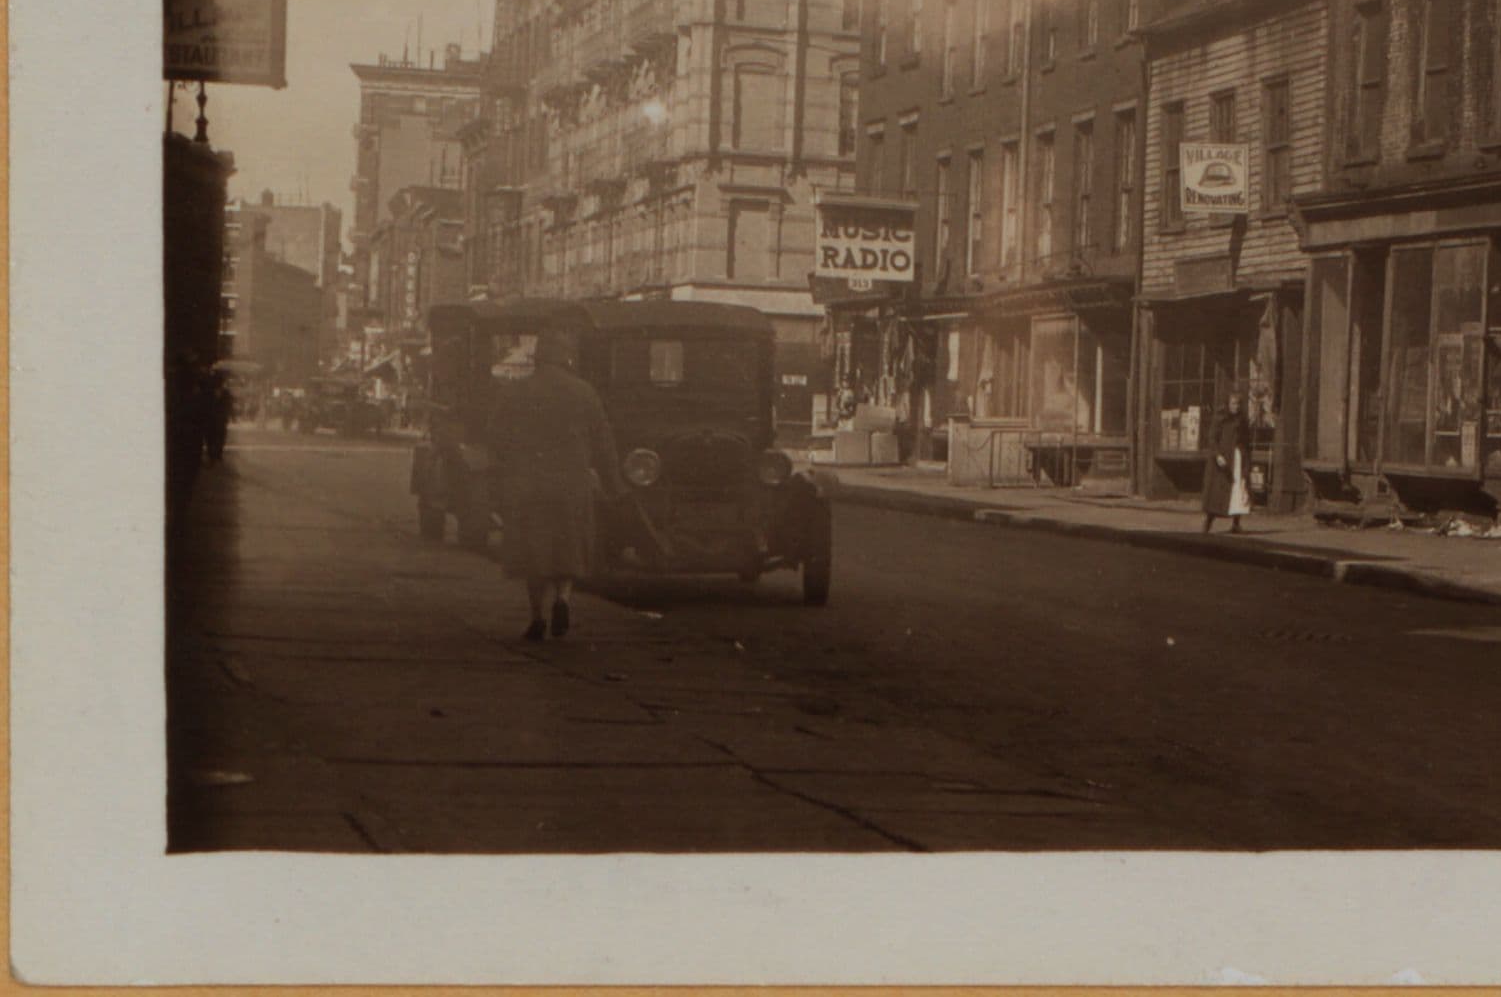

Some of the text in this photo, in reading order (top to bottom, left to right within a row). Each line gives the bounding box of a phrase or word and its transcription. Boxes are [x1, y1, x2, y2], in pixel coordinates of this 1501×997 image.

[1185, 148, 1243, 166] VILLAGE
[1185, 186, 1245, 206] RENOVATING
[820, 217, 911, 242] MUSIC
[820, 245, 911, 272] RADIO
